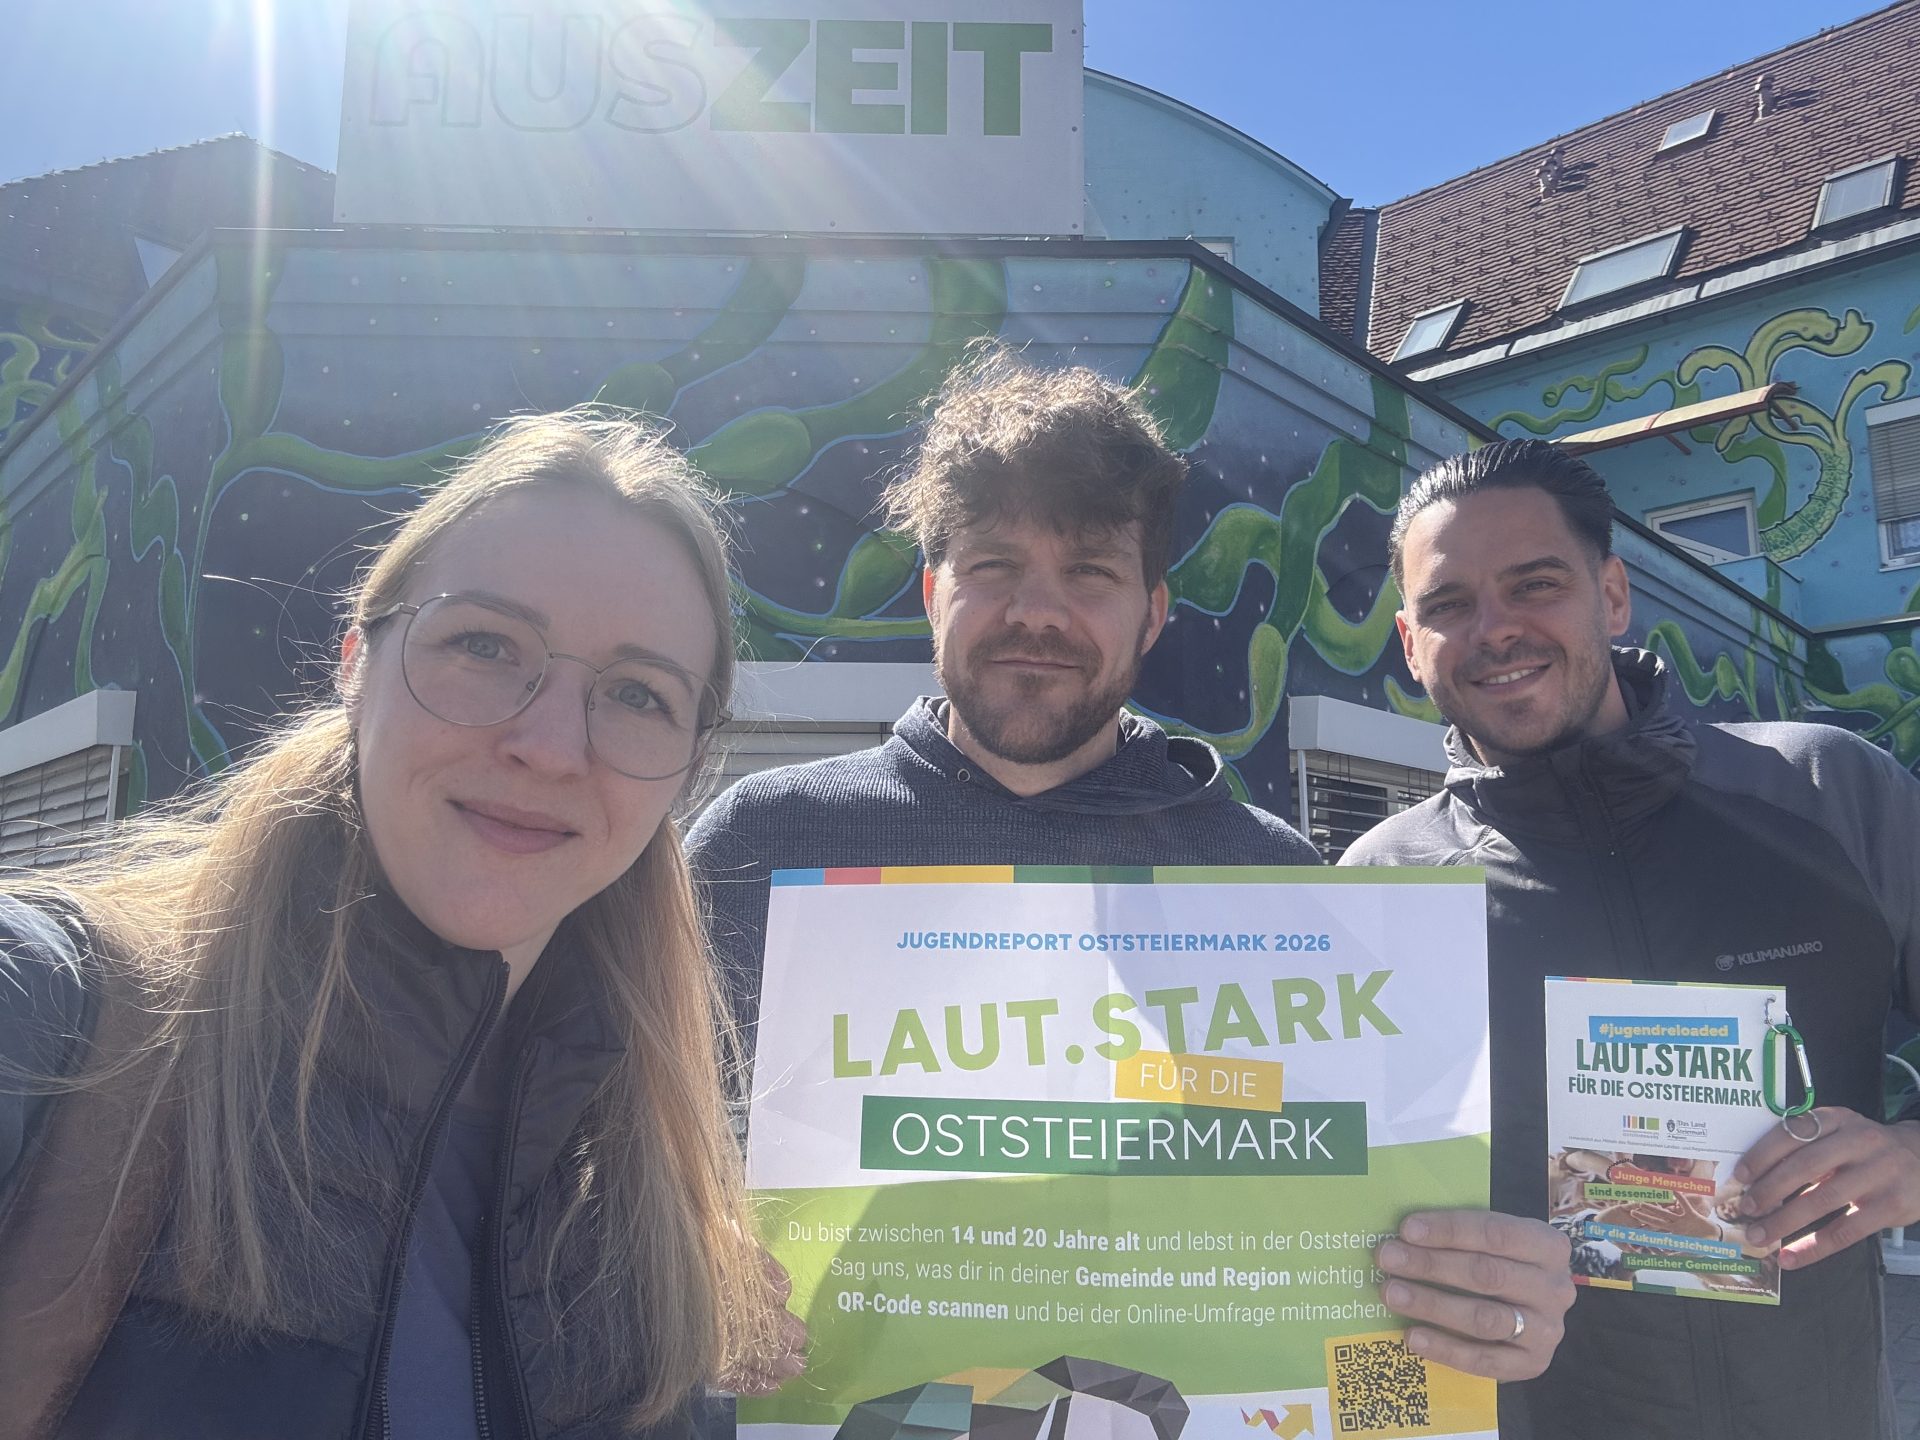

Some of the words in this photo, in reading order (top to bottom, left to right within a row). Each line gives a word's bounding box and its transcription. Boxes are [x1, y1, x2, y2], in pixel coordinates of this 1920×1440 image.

[368, 13, 1053, 136] AUSZEIT
[896, 932, 1072, 951] JUGENDREPORT
[1078, 933, 1268, 952] OSTSTEIERMARK
[1274, 934, 1331, 952] 2026
[1737, 940, 1823, 965] KILIMANJARO
[832, 969, 1402, 1079] LAUT.STARK
[1599, 1023, 1729, 1038] #jugendreloaded
[1576, 1039, 1753, 1082] LAUT.STARK
[1139, 1060, 1198, 1094] FÜR
[1209, 1072, 1258, 1098] DIE
[1568, 1074, 1597, 1095] FÜR
[1601, 1079, 1624, 1097] DIE
[1628, 1081, 1762, 1107] OSTSTEIERMARK
[892, 1112, 1335, 1161] OSTSTEIERMARK
[1691, 1120, 1706, 1128] Land
[1589, 1186, 1612, 1197] sind
[1614, 1188, 1670, 1200] essenziell
[1614, 1170, 1650, 1185] Junge
[1652, 1176, 1711, 1193] Menschen
[788, 1221, 812, 1241] Du
[818, 1222, 852, 1243] bist
[858, 1223, 944, 1243] zwischen
[952, 1225, 975, 1244] 14
[981, 1226, 1016, 1246] und
[1023, 1228, 1047, 1247] 20
[1053, 1229, 1109, 1251] Jahre
[1115, 1231, 1140, 1251] alt
[1146, 1231, 1181, 1251] und
[1188, 1231, 1234, 1251] lebst
[1241, 1231, 1256, 1250] in
[1263, 1230, 1293, 1250] der
[1589, 1225, 1605, 1236] für
[1608, 1229, 1626, 1240] die
[1628, 1231, 1737, 1257] Zukunftssicherung
[831, 1257, 865, 1280] Sag
[872, 1261, 909, 1279] uns,
[915, 1263, 952, 1279] was
[959, 1260, 982, 1281] dir
[989, 1262, 1004, 1282] in
[1011, 1263, 1069, 1285] deiner
[1075, 1266, 1174, 1288] Gemeinde
[1180, 1267, 1216, 1287] und
[1223, 1266, 1290, 1291] Region
[1297, 1264, 1364, 1288] wichtig
[1371, 1265, 1391, 1284] is
[1627, 1256, 1683, 1269] ländlicher
[1685, 1260, 1755, 1273] Gemeinden.
[837, 1291, 921, 1315] QR-Code
[927, 1300, 1009, 1320] scannen
[1015, 1301, 1049, 1322] und
[1057, 1302, 1083, 1322] bei
[1090, 1303, 1121, 1324] der
[1127, 1302, 1275, 1327] Online-Umfrage
[1282, 1299, 1392, 1322] mitmachen.
